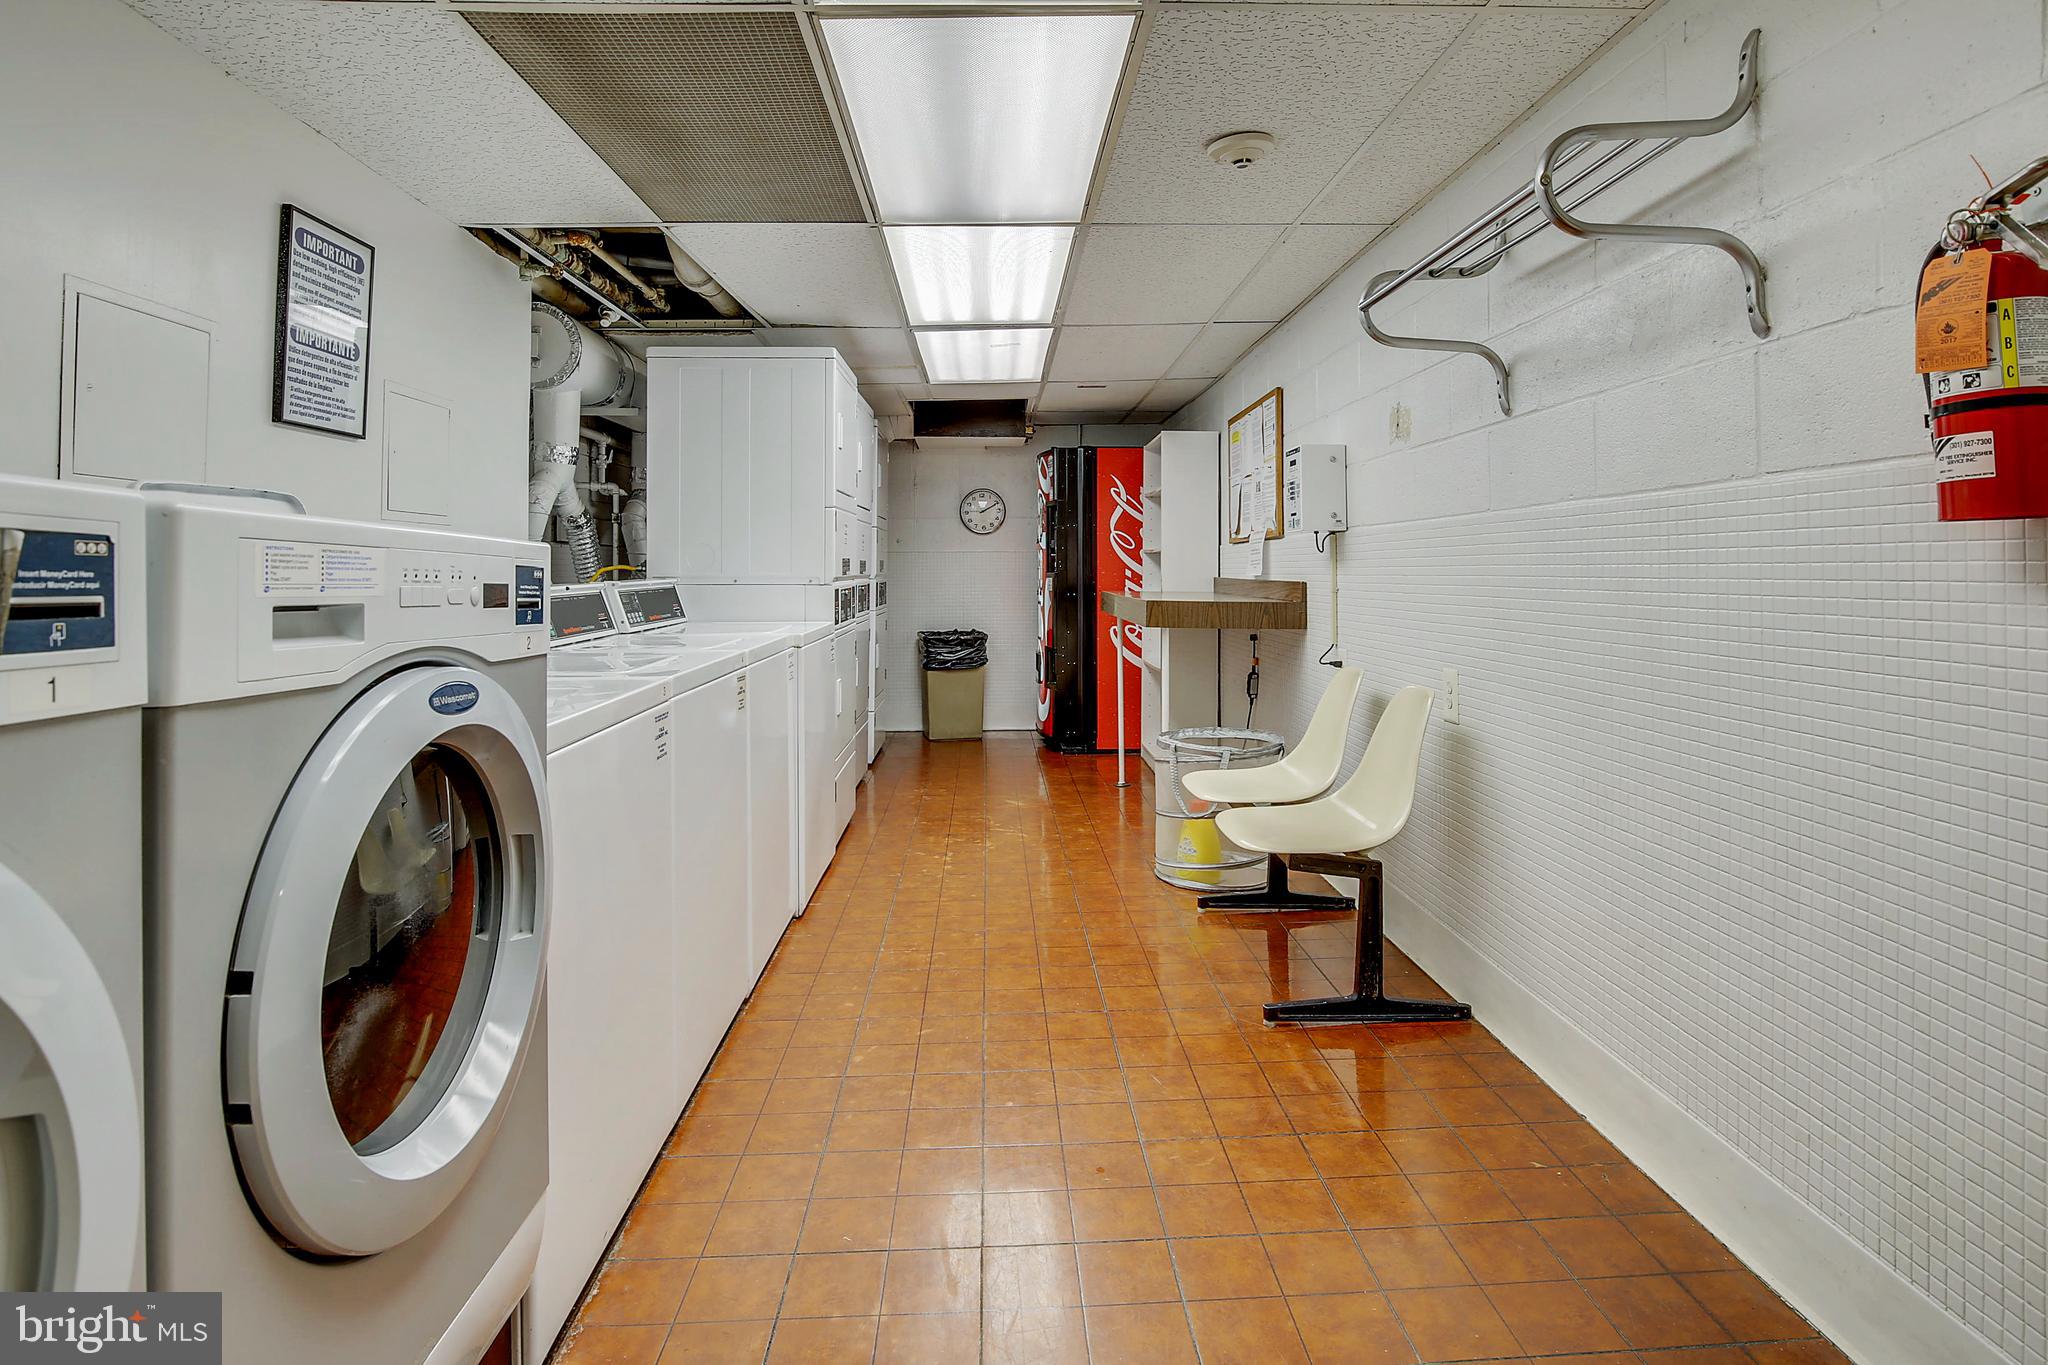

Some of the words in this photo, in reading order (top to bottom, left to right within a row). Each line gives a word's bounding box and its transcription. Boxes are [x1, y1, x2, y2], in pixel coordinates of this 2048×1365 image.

[303, 233, 357, 272] IMPORTANT
[2003, 308, 2011, 320] A
[296, 328, 355, 360] IMPORTANTE
[1940, 336, 1957, 344] 2017
[2004, 337, 2012, 349] B
[2007, 365, 2014, 377] C
[1950, 441, 1962, 450] (301)
[1963, 438, 1992, 447] 927-7300
[1953, 450, 1993, 459] EXTINGUISHER
[40, 570, 78, 579] MoneyCard
[526, 636, 531, 650] 2
[48, 676, 56, 702] 1
[440, 692, 476, 704] Wascomat
